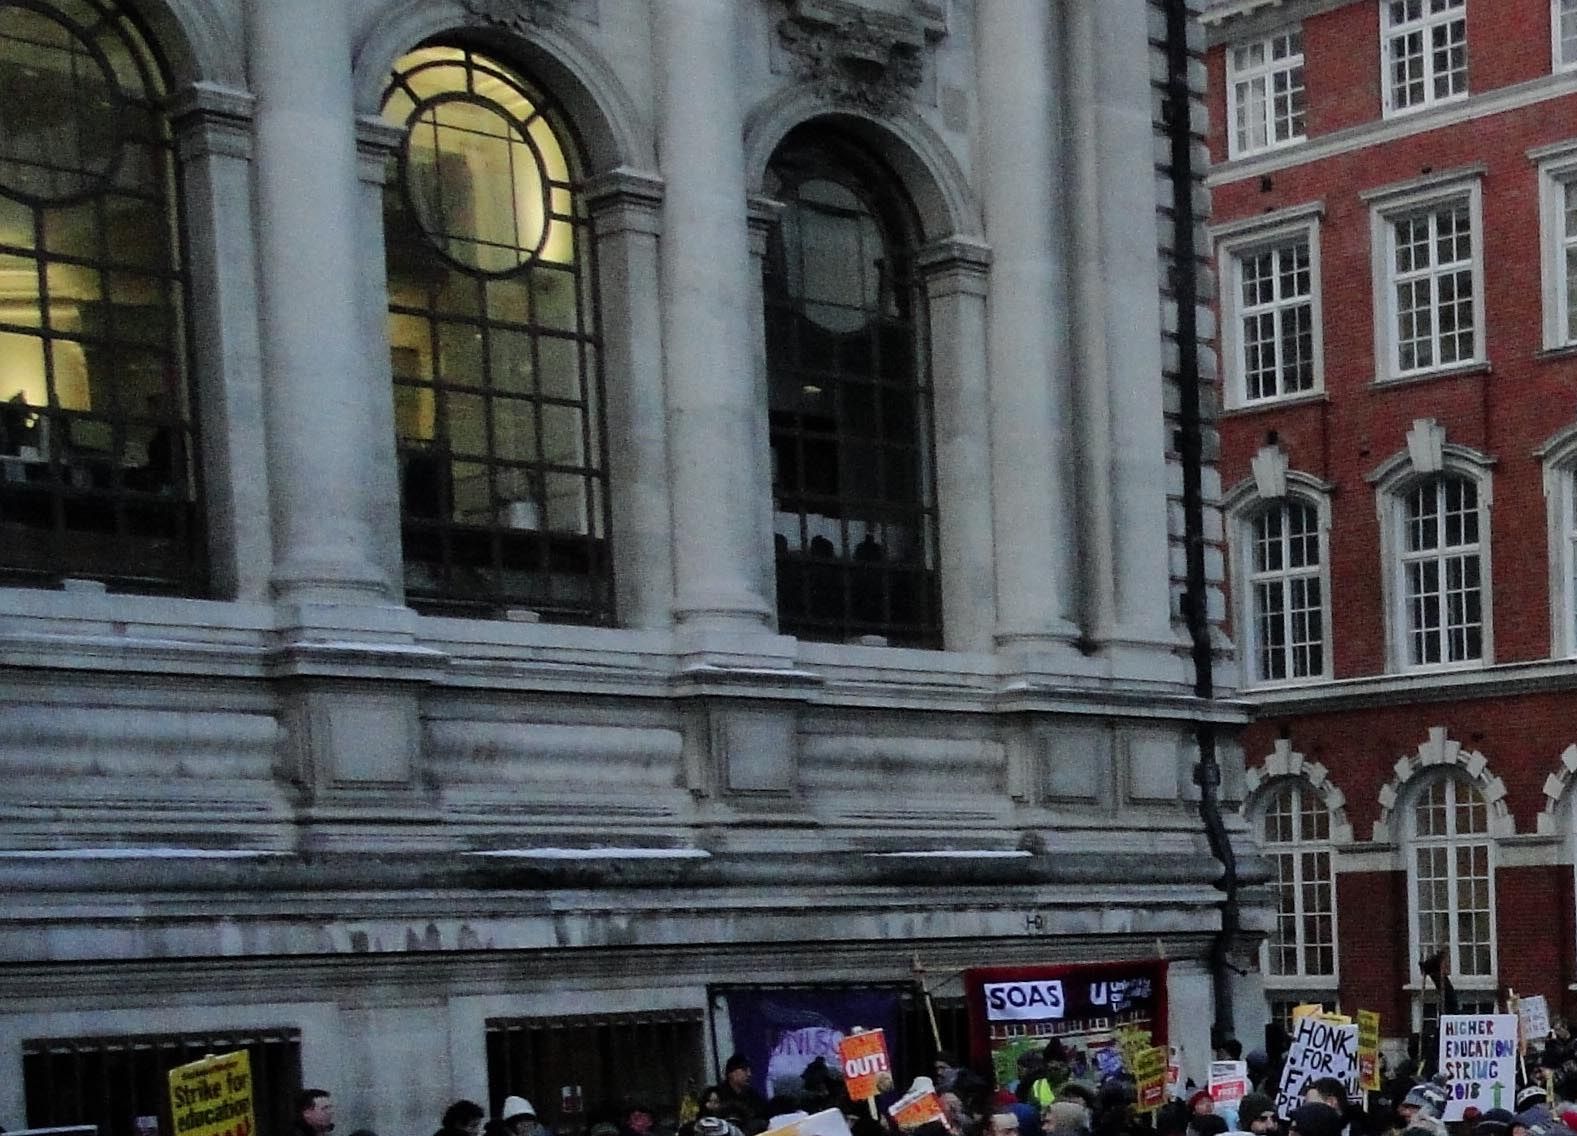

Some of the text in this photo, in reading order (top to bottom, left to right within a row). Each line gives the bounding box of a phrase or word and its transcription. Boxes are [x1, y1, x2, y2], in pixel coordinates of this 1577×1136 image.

[990, 985, 1061, 1010] SOAS
[1297, 1018, 1354, 1058] HONK
[1446, 1020, 1494, 1035] HIGHER
[1301, 1049, 1333, 1073] FOR
[1446, 1040, 1513, 1058] EDUCATION
[845, 1053, 888, 1078] OUT!
[1446, 1061, 1498, 1080] SPRING
[175, 1072, 247, 1108] Strike for
[1446, 1082, 1481, 1100] 2018
[178, 1099, 250, 1132] education
